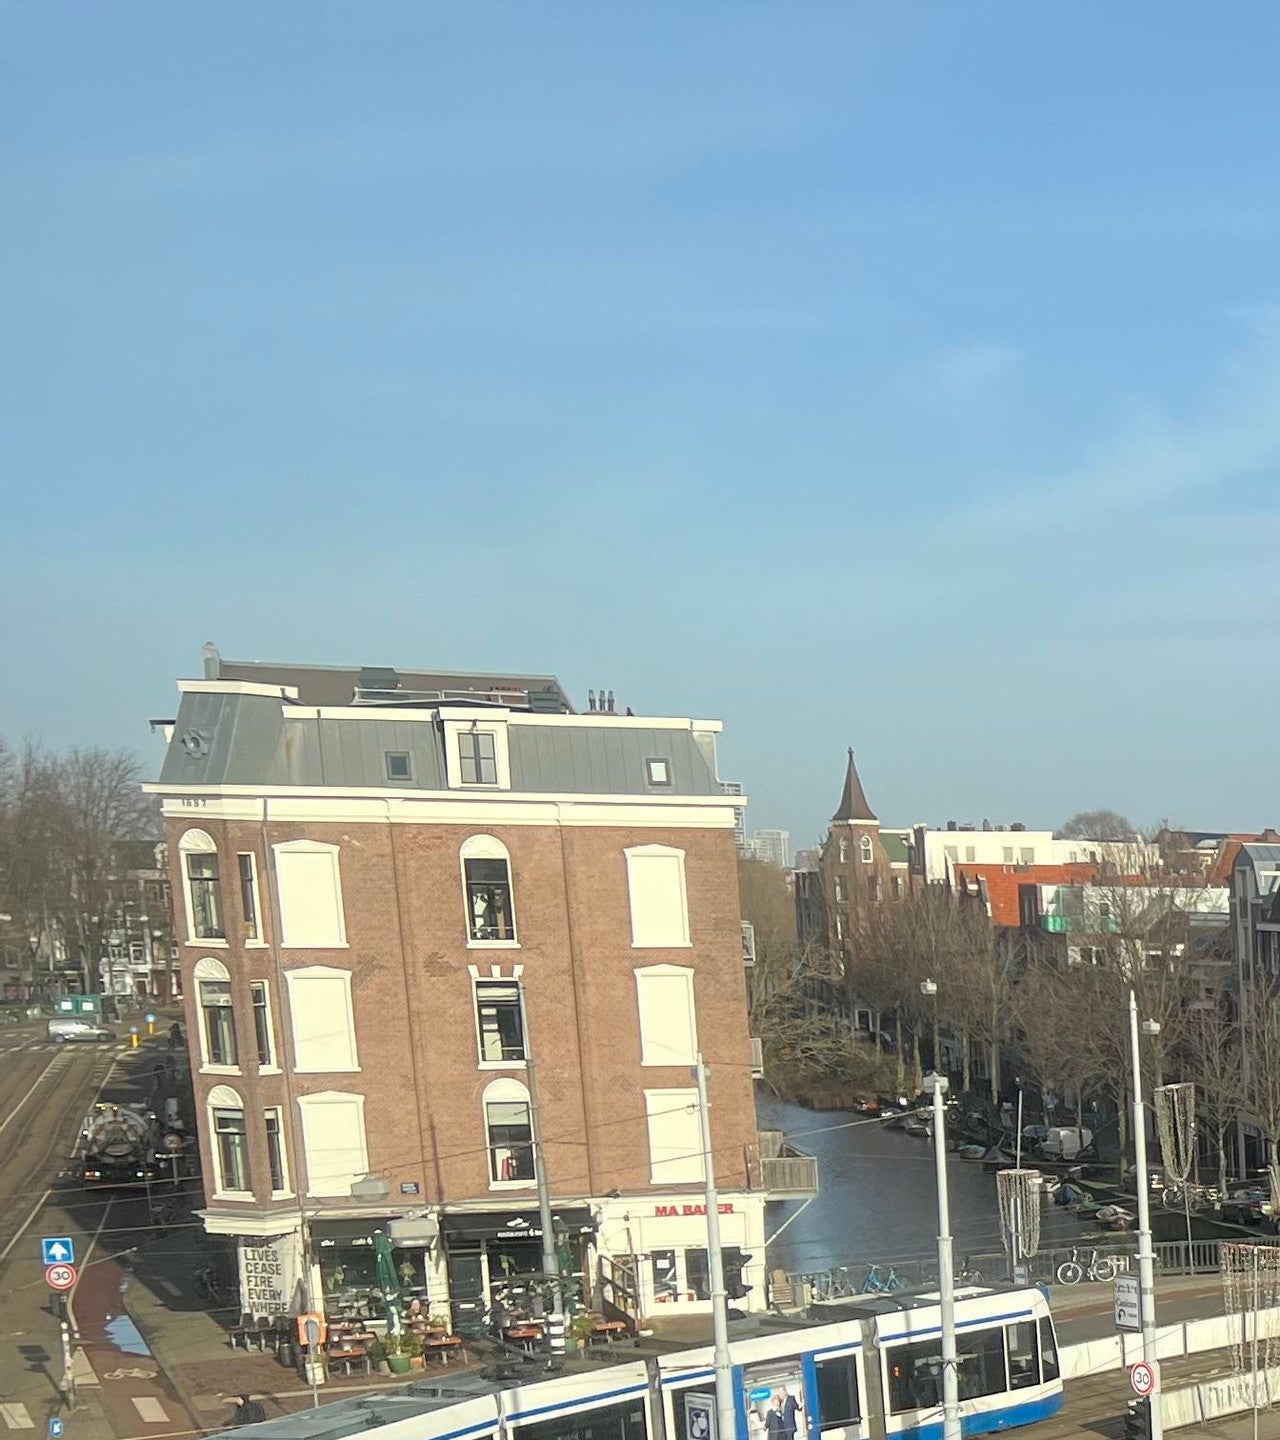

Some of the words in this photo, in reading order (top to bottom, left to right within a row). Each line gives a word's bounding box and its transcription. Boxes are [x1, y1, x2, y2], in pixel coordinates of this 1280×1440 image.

[655, 1206, 679, 1218] MA
[243, 1248, 279, 1262] LIVES
[245, 1262, 282, 1276] CEASE
[53, 1271, 70, 1281] 30
[246, 1275, 274, 1288] FIRE
[247, 1288, 282, 1301] EVERY
[248, 1301, 289, 1317] WHERE
[1135, 1371, 1150, 1386] 30
